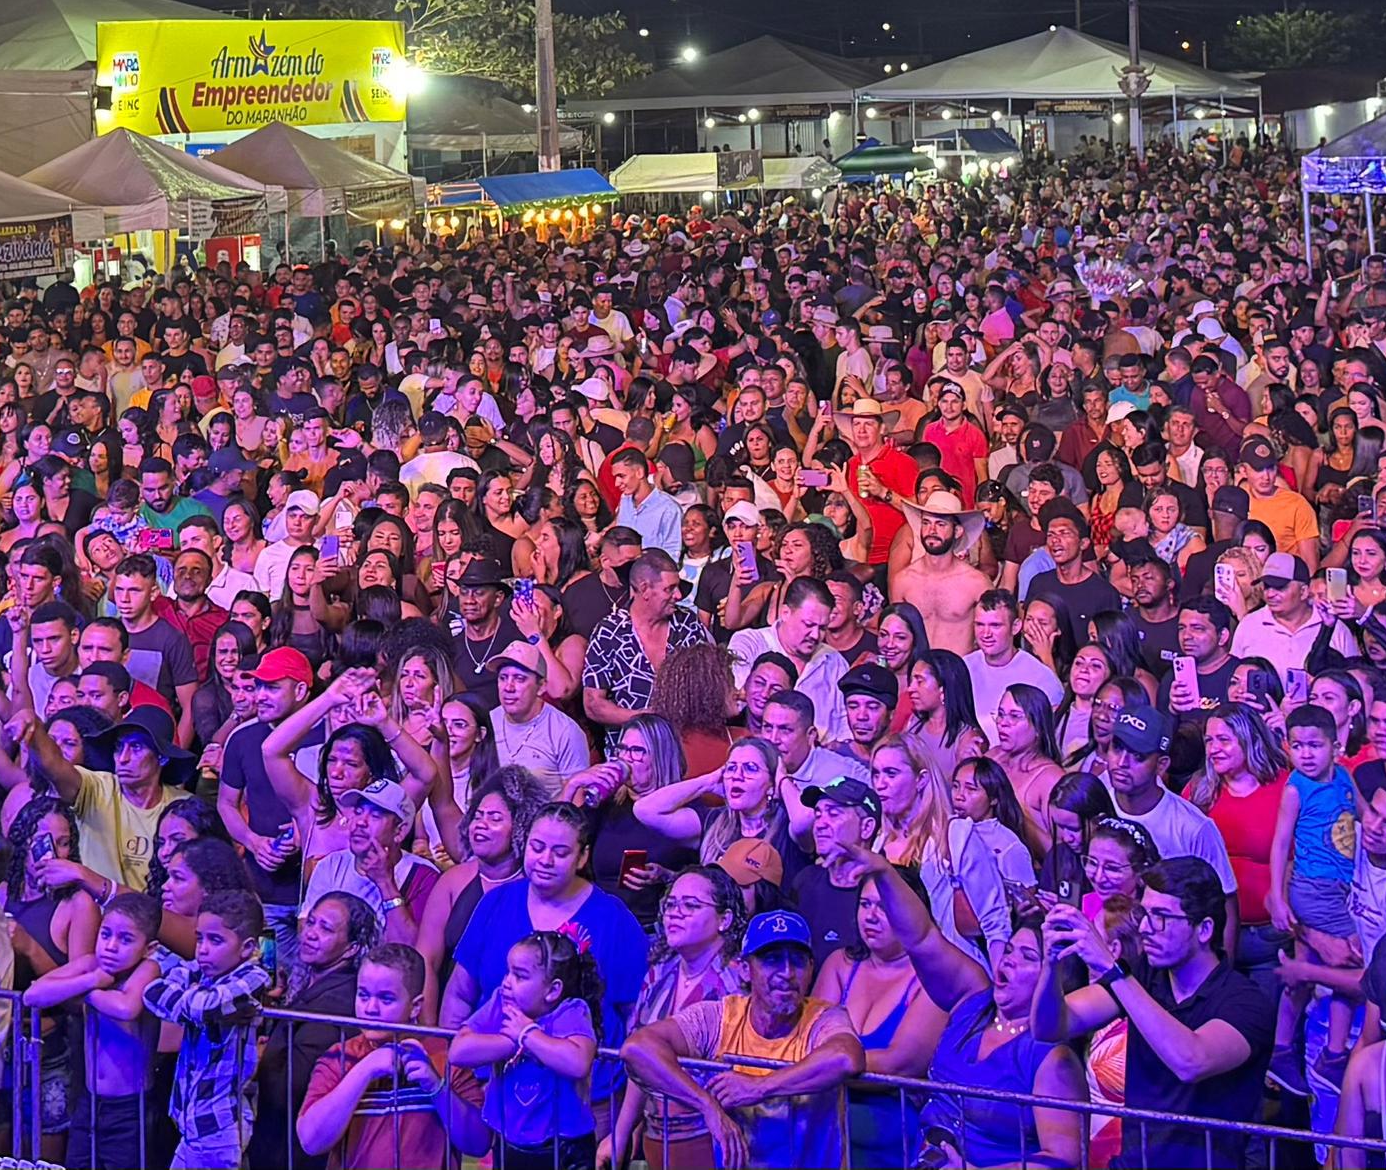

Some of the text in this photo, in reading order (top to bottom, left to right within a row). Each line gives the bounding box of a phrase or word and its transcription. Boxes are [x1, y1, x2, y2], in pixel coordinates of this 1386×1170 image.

[305, 47, 324, 76] do
[191, 78, 334, 112] Empreendedor
[226, 104, 307, 125] DO MARANHÃO
